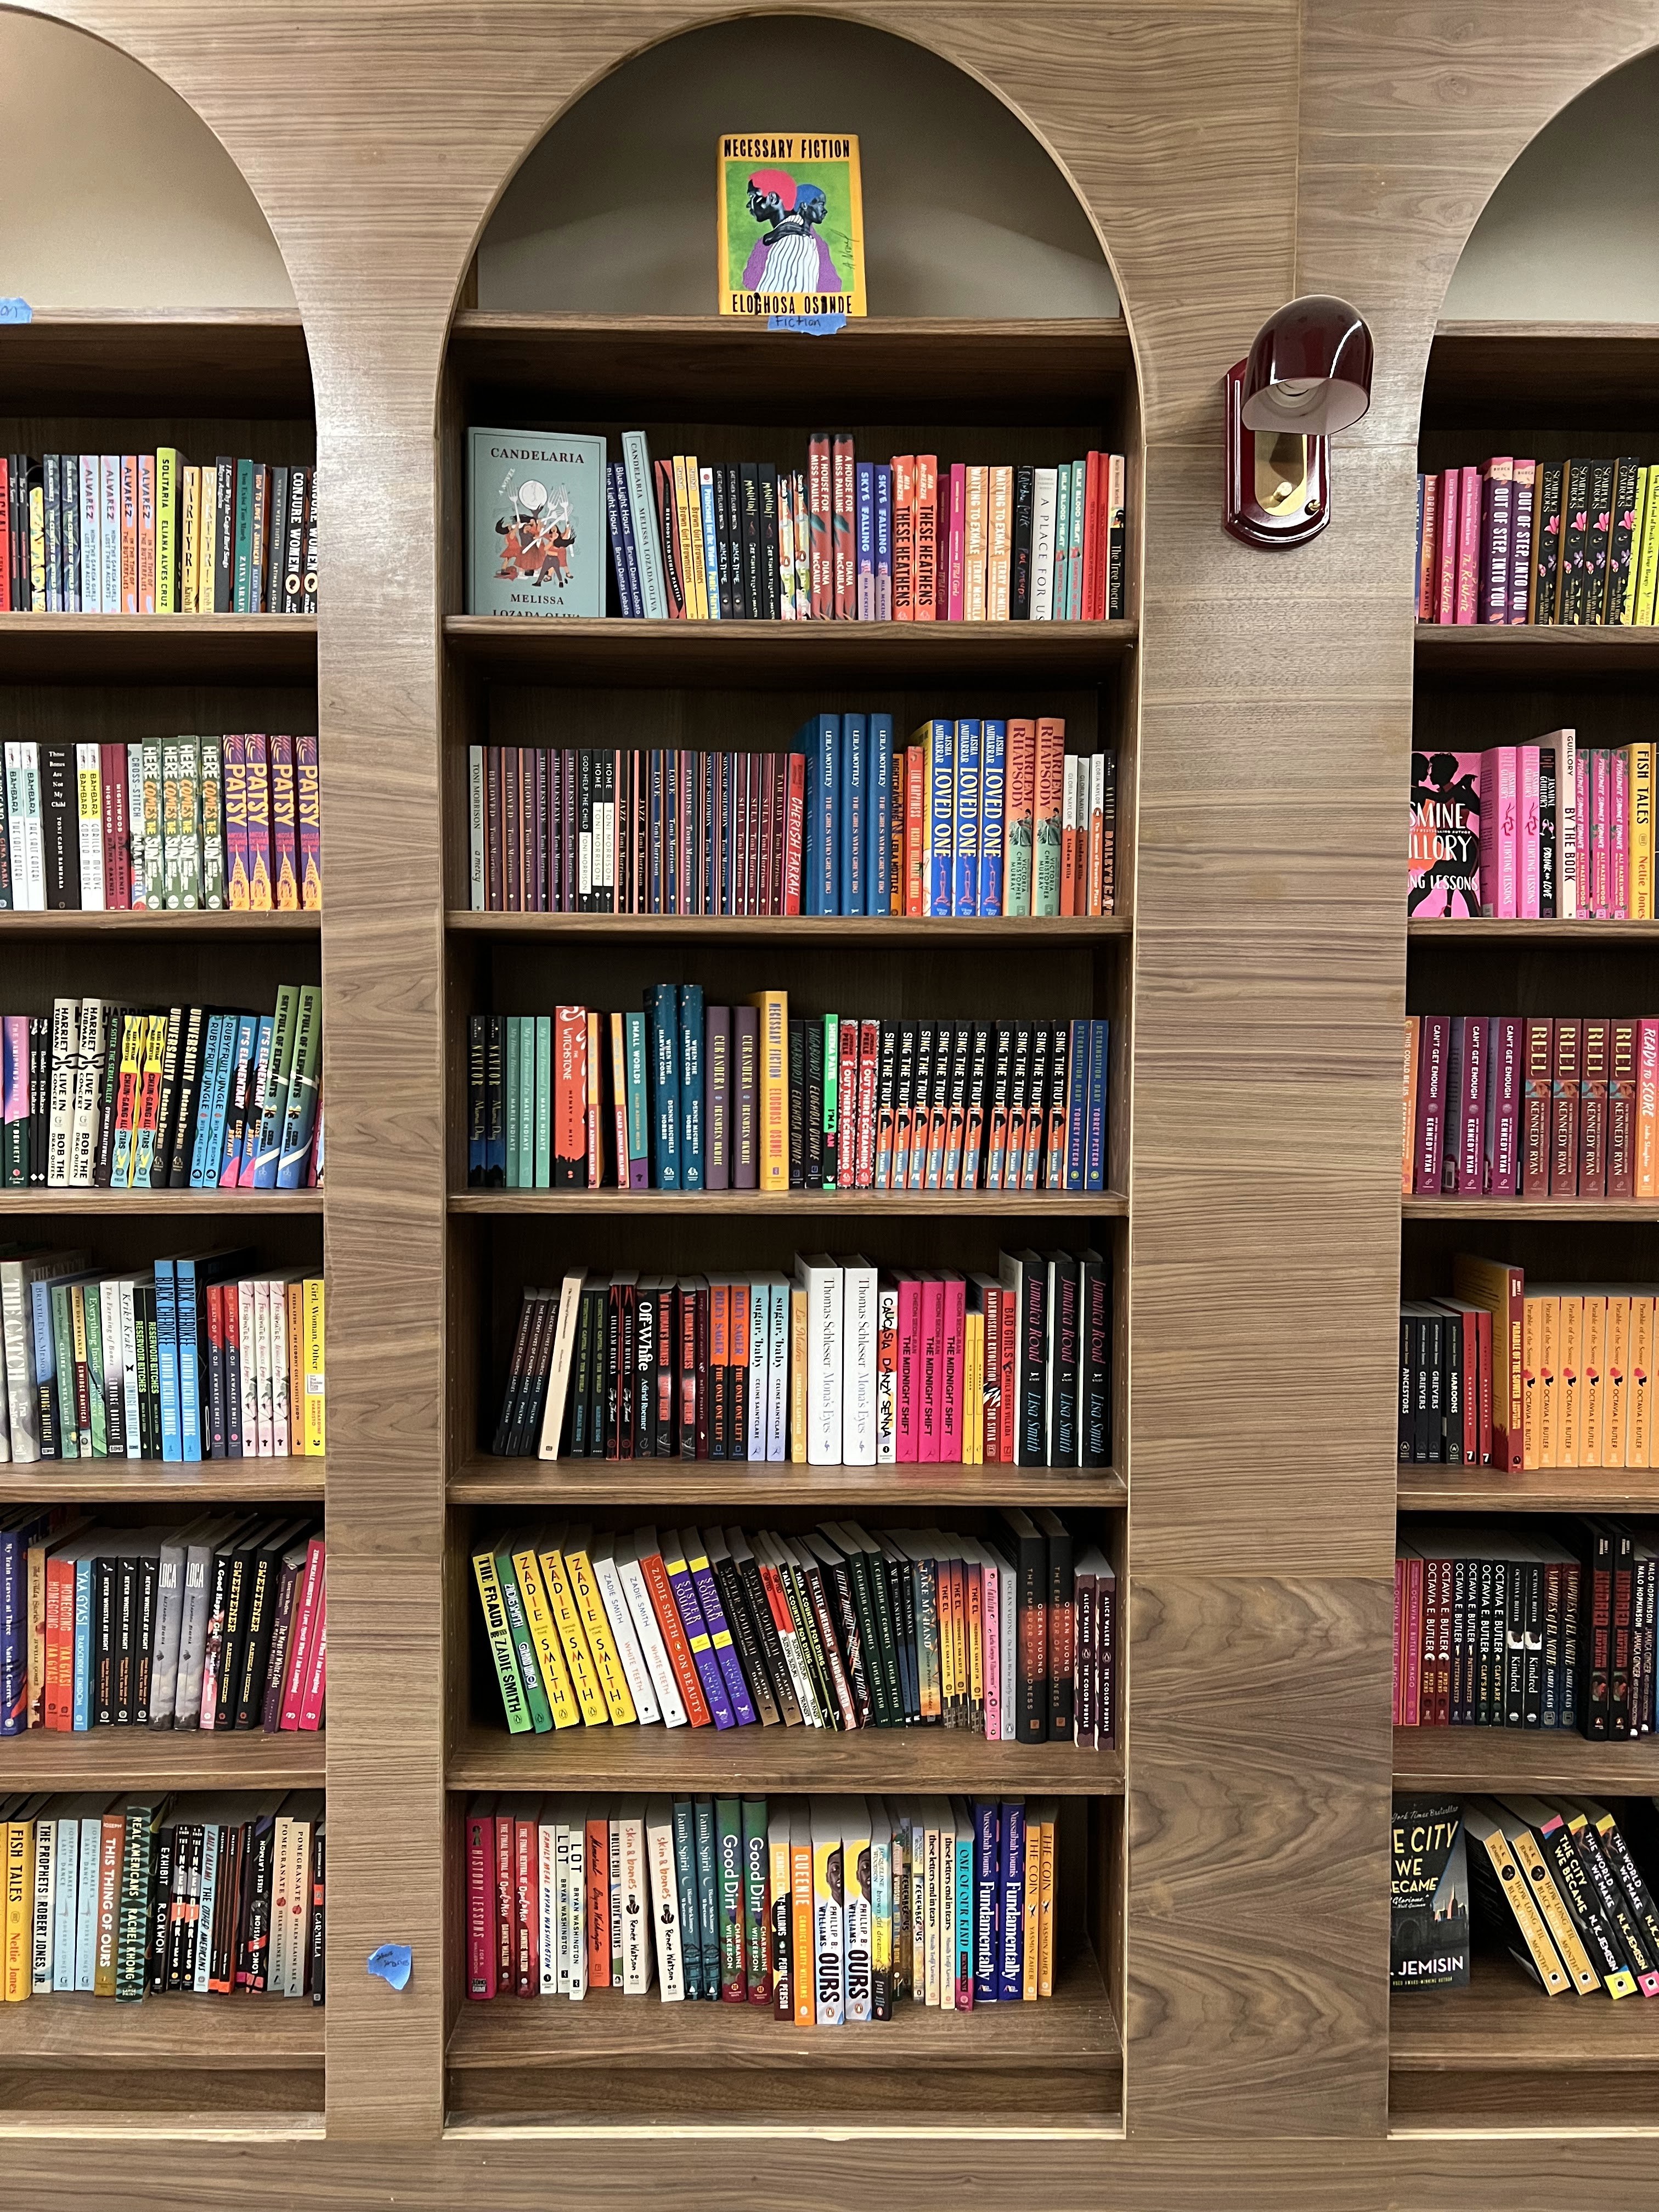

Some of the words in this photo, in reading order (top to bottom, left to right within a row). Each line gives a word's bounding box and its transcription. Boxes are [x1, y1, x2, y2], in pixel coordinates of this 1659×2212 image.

[724, 139, 793, 158] NECESSARY
[802, 139, 850, 158] FICTION
[732, 293, 795, 315] ELOGHOSA
[490, 448, 584, 463] CANDELARIA
[811, 454, 819, 476] MISS
[161, 459, 170, 508] SOLITARIA
[616, 466, 626, 484] Blue
[995, 469, 1006, 507] WAITING
[291, 472, 304, 523] CONJURE
[618, 487, 628, 508] Light
[811, 478, 819, 514] PAULINE
[1517, 492, 1532, 512] OUT
[620, 510, 631, 535] Hours
[919, 505, 934, 541] THESE
[996, 510, 1006, 521] TO
[1516, 515, 1531, 527] OF
[289, 529, 301, 573] WOMEN
[994, 523, 1006, 555] EXHALE
[1111, 545, 1121, 560] The
[1514, 532, 1530, 557] STEP,
[627, 546, 635, 566] Bruna
[1111, 562, 1120, 580] Tree
[629, 567, 639, 590] Dantas
[812, 552, 821, 594] McCAULAY
[918, 545, 933, 606] HEATHENS
[1514, 562, 1528, 586] INTO
[511, 594, 564, 605] MELISSA
[632, 591, 641, 614] Lobato
[1110, 582, 1120, 610] Doctor
[1513, 590, 1527, 610] YOU
[203, 746, 218, 778] HERE
[1040, 726, 1054, 810] RHAPSODY
[1637, 750, 1649, 778] FISH
[90, 773, 98, 816] BAMBARA
[132, 757, 141, 817] CROSS-STITCH
[206, 781, 218, 819] COMES
[298, 765, 319, 827] PATSY
[985, 767, 1003, 819] LOVED
[1565, 808, 1575, 821] BY
[1637, 788, 1649, 825] TALES
[207, 821, 217, 834] THE
[791, 797, 803, 848] CHERISH
[1565, 826, 1575, 848] THE
[205, 836, 218, 860] SUN
[984, 823, 1002, 857] ONE
[788, 851, 801, 896] FARRAH
[1564, 852, 1575, 882] BOOK
[60, 1007, 69, 1052] HARRIET
[183, 1008, 202, 1081] UNIVERSALITY
[956, 1031, 968, 1053] SING
[1505, 1025, 1514, 1048] CAN'T
[218, 1022, 234, 1073] RUBYFRUIT
[562, 1027, 573, 1080] WITCHSTONE
[1505, 1049, 1513, 1064] GET
[1615, 1027, 1632, 1077] REEL
[863, 1068, 872, 1087] OUT
[953, 1057, 966, 1076] THE
[1504, 1066, 1513, 1098] ENOUGH
[59, 1073, 67, 1096] LIVE
[215, 1075, 227, 1109] JUNGLE
[951, 1079, 964, 1114] TRUTH
[58, 1099, 66, 1111] IN
[862, 1089, 871, 1116] THERE
[1614, 1102, 1624, 1149] KENNEDY
[57, 1133, 65, 1156] BOB
[860, 1118, 870, 1170] SCREAMING
[57, 1159, 65, 1180] THE
[1613, 1151, 1623, 1176] RYAN
[177, 1277, 195, 1302] BLACK
[311, 1283, 319, 1304] Girl,
[857, 1277, 870, 1319] Thomas
[1090, 1277, 1106, 1326] Jamaica
[87, 1297, 98, 1345] Everything
[178, 1307, 196, 1346] CHEROKEE
[311, 1306, 319, 1342] Woman,
[637, 1301, 653, 1371] Off-White
[148, 1322, 157, 1362] RESERVOIR
[311, 1344, 320, 1370] Other
[857, 1322, 870, 1368] Schlesser
[946, 1336, 955, 1356] THE
[1092, 1329, 1106, 1364] Road
[150, 1363, 159, 1394] BITCHES
[945, 1357, 955, 1404] MIDNIGHT
[1091, 1393, 1104, 1417] Lisa
[944, 1407, 953, 1436] SHIFT
[1090, 1420, 1104, 1453] Smith
[478, 1557, 493, 1583] THE
[920, 1567, 929, 1595] TAKE
[1494, 1564, 1504, 1607] OCTAVIA
[1647, 1562, 1655, 1581] NALO
[227, 1560, 243, 1633] SWEETENER
[484, 1586, 503, 1628] FRAUD
[922, 1599, 929, 1615] MY
[1646, 1583, 1654, 1624] HOPKINSON
[1494, 1610, 1503, 1618] E.
[923, 1618, 932, 1649] HAND
[1494, 1621, 1503, 1653] BUTLER
[494, 1638, 510, 1673] ZADIE
[1528, 1656, 1539, 1694] Kindred
[503, 1674, 522, 1713] SMITH
[40, 1825, 51, 1842] THE
[1411, 1820, 1459, 1850] CITY
[105, 1838, 116, 1865] THIS
[571, 1843, 582, 1873] LOT
[749, 1837, 765, 1881] Good
[38, 1846, 50, 1893] PROPHETS
[795, 1855, 810, 1906] QUEENIE
[103, 1870, 115, 1910] THING
[749, 1884, 765, 1912] Dirt
[36, 1901, 48, 1937] ROBERT
[101, 1913, 112, 1931] OF
[1002, 1882, 1021, 1980] Fundamentally
[33, 1940, 47, 1971] JONES,
[100, 1933, 111, 1967] OURS
[35, 1973, 46, 1987] JR.
[848, 1949, 868, 1999] OURS
[1398, 1956, 1464, 1976] JEMISIN
